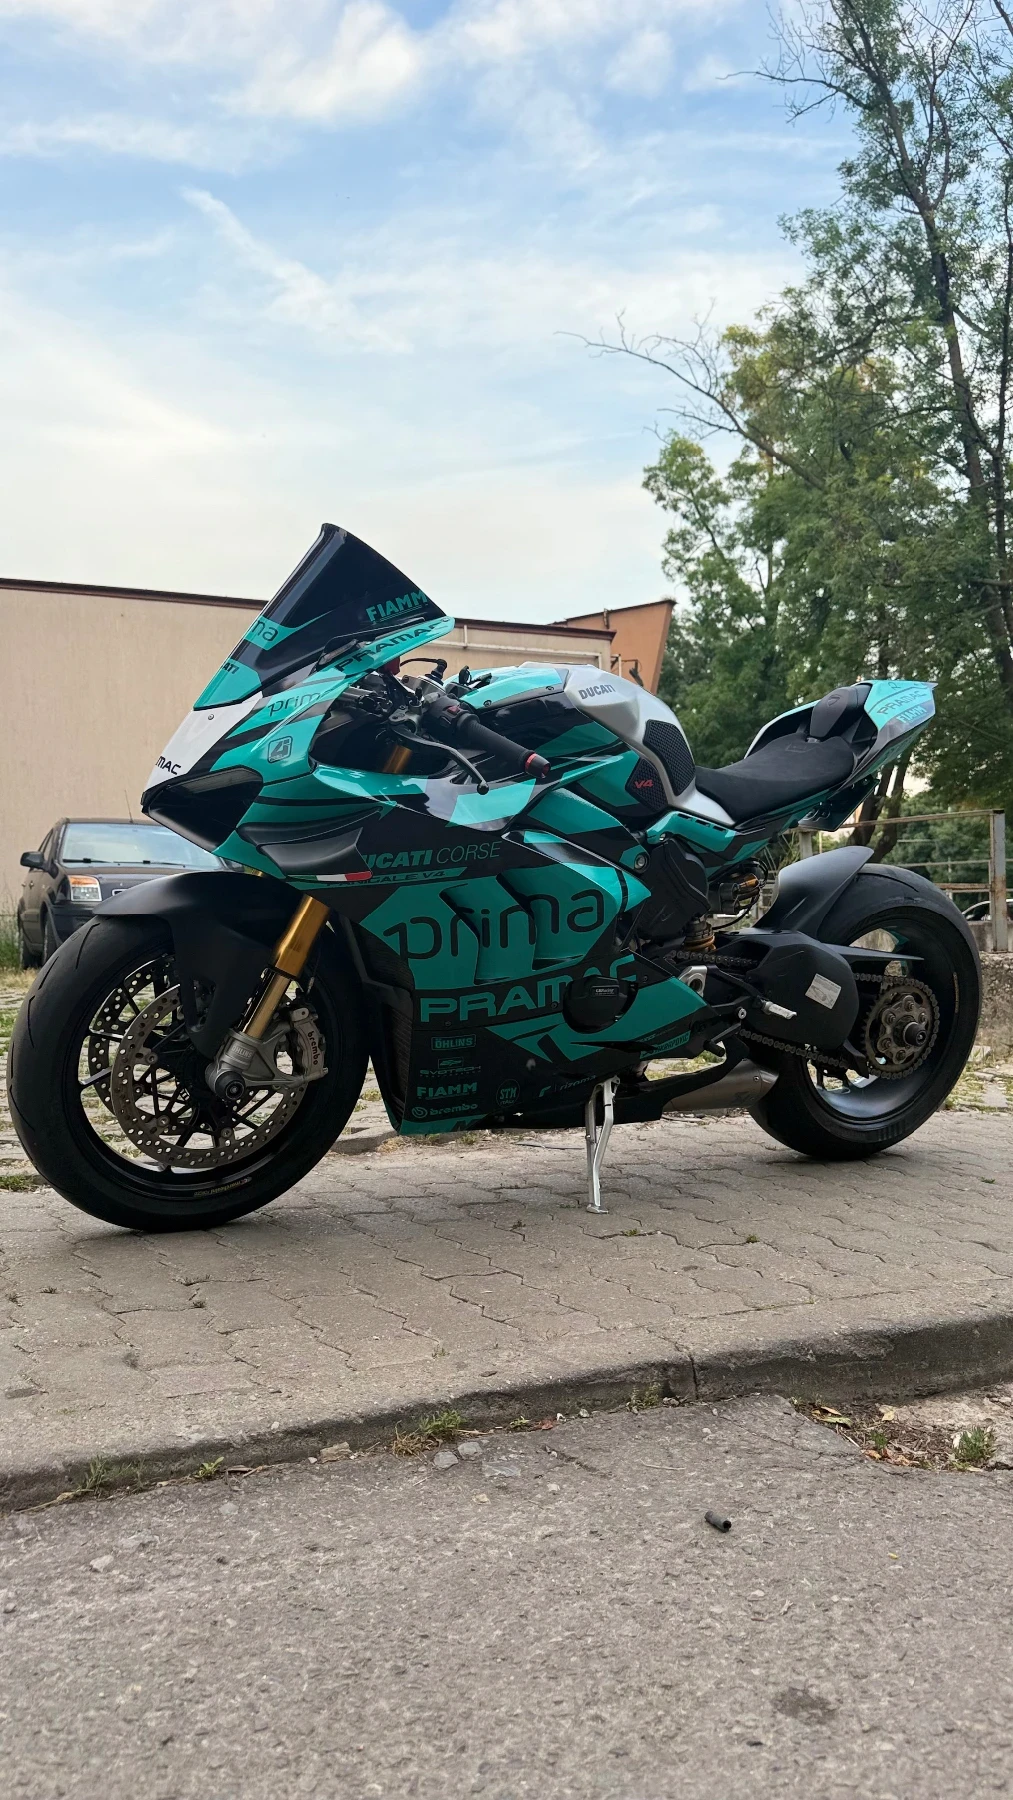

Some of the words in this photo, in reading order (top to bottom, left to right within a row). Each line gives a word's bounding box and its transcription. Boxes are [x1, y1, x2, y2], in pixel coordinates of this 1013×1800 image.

[365, 589, 428, 622] FIAMM
[578, 683, 617, 700] DUCATI
[155, 755, 182, 776] MAC
[634, 779, 654, 789] V4
[363, 850, 433, 869] UCATI
[437, 841, 502, 865] CORSE
[423, 870, 446, 879] V4
[382, 888, 605, 960] prima
[420, 953, 637, 1023] PRAMC
[306, 1030, 320, 1066] brembo
[434, 1037, 474, 1049] ÖHLINS
[416, 1081, 478, 1097] FIAMM
[499, 1087, 518, 1100] STM
[429, 1103, 479, 1116] brembo
